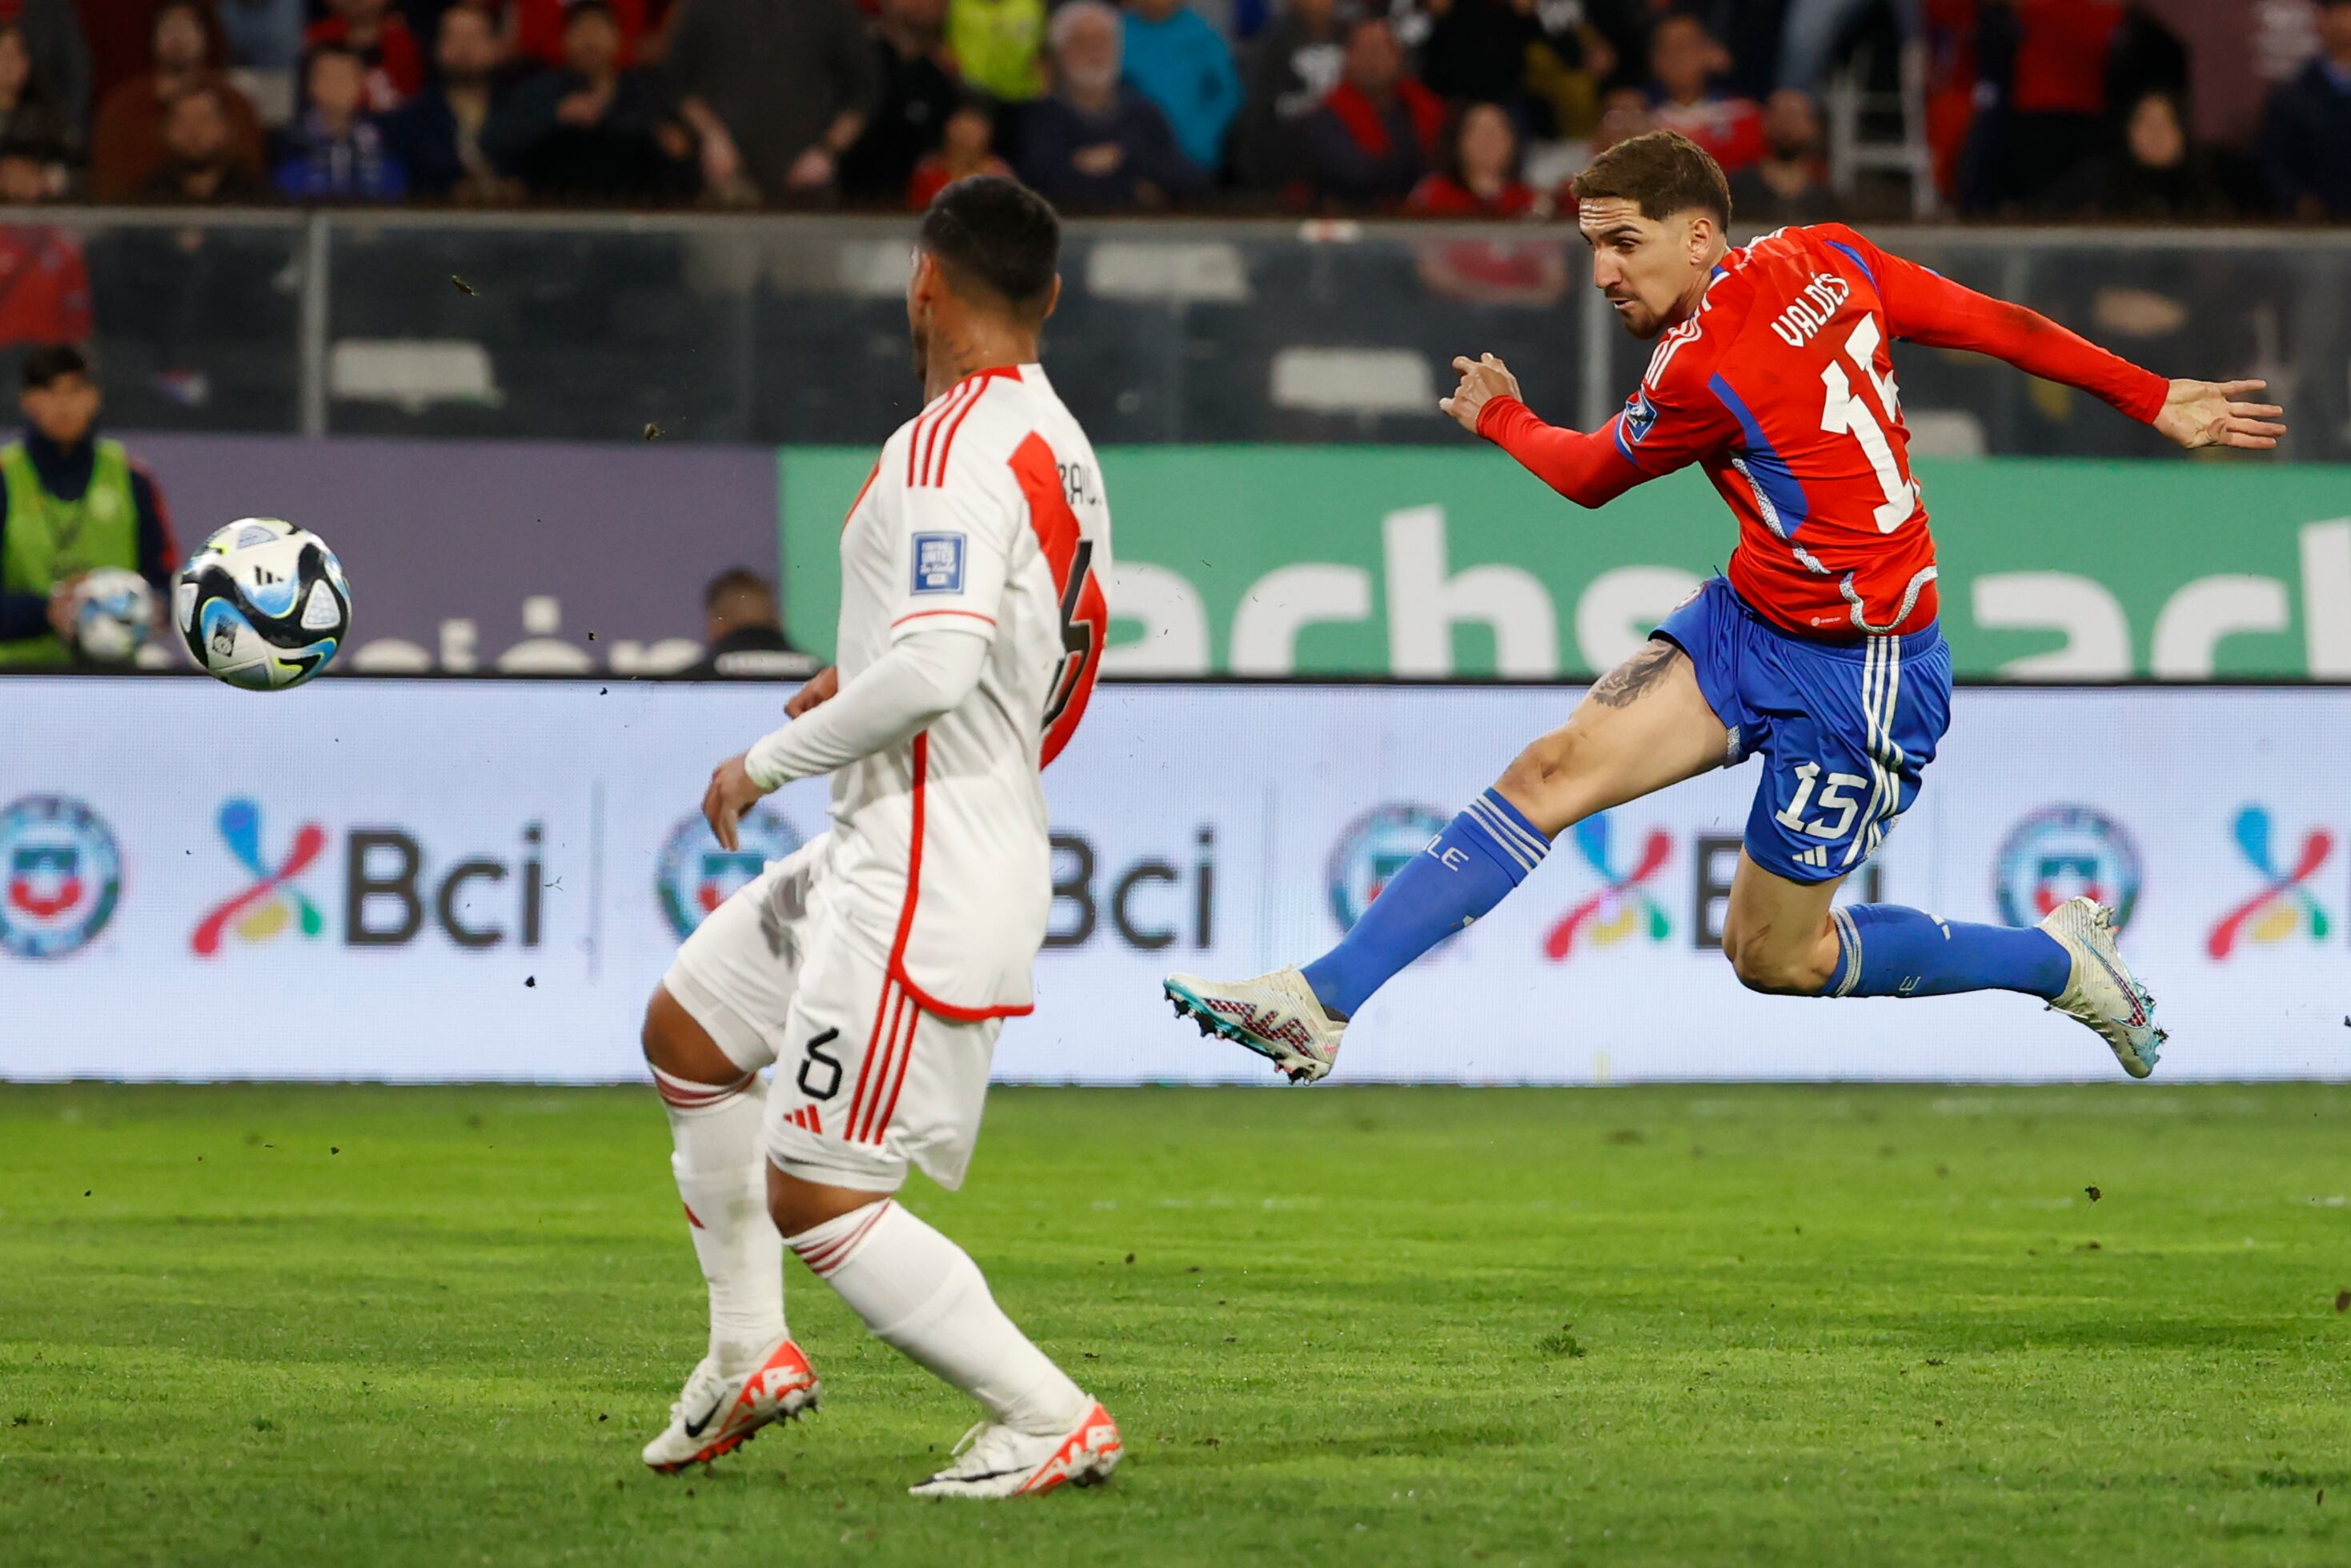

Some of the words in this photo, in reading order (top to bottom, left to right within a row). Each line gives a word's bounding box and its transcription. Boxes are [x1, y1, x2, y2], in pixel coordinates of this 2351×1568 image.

[1770, 271, 1850, 347] VALDÉS
[1775, 760, 1868, 840] 15
[346, 823, 544, 948] Bci
[1041, 828, 1214, 948] Bci
[796, 1025, 843, 1101] 6
